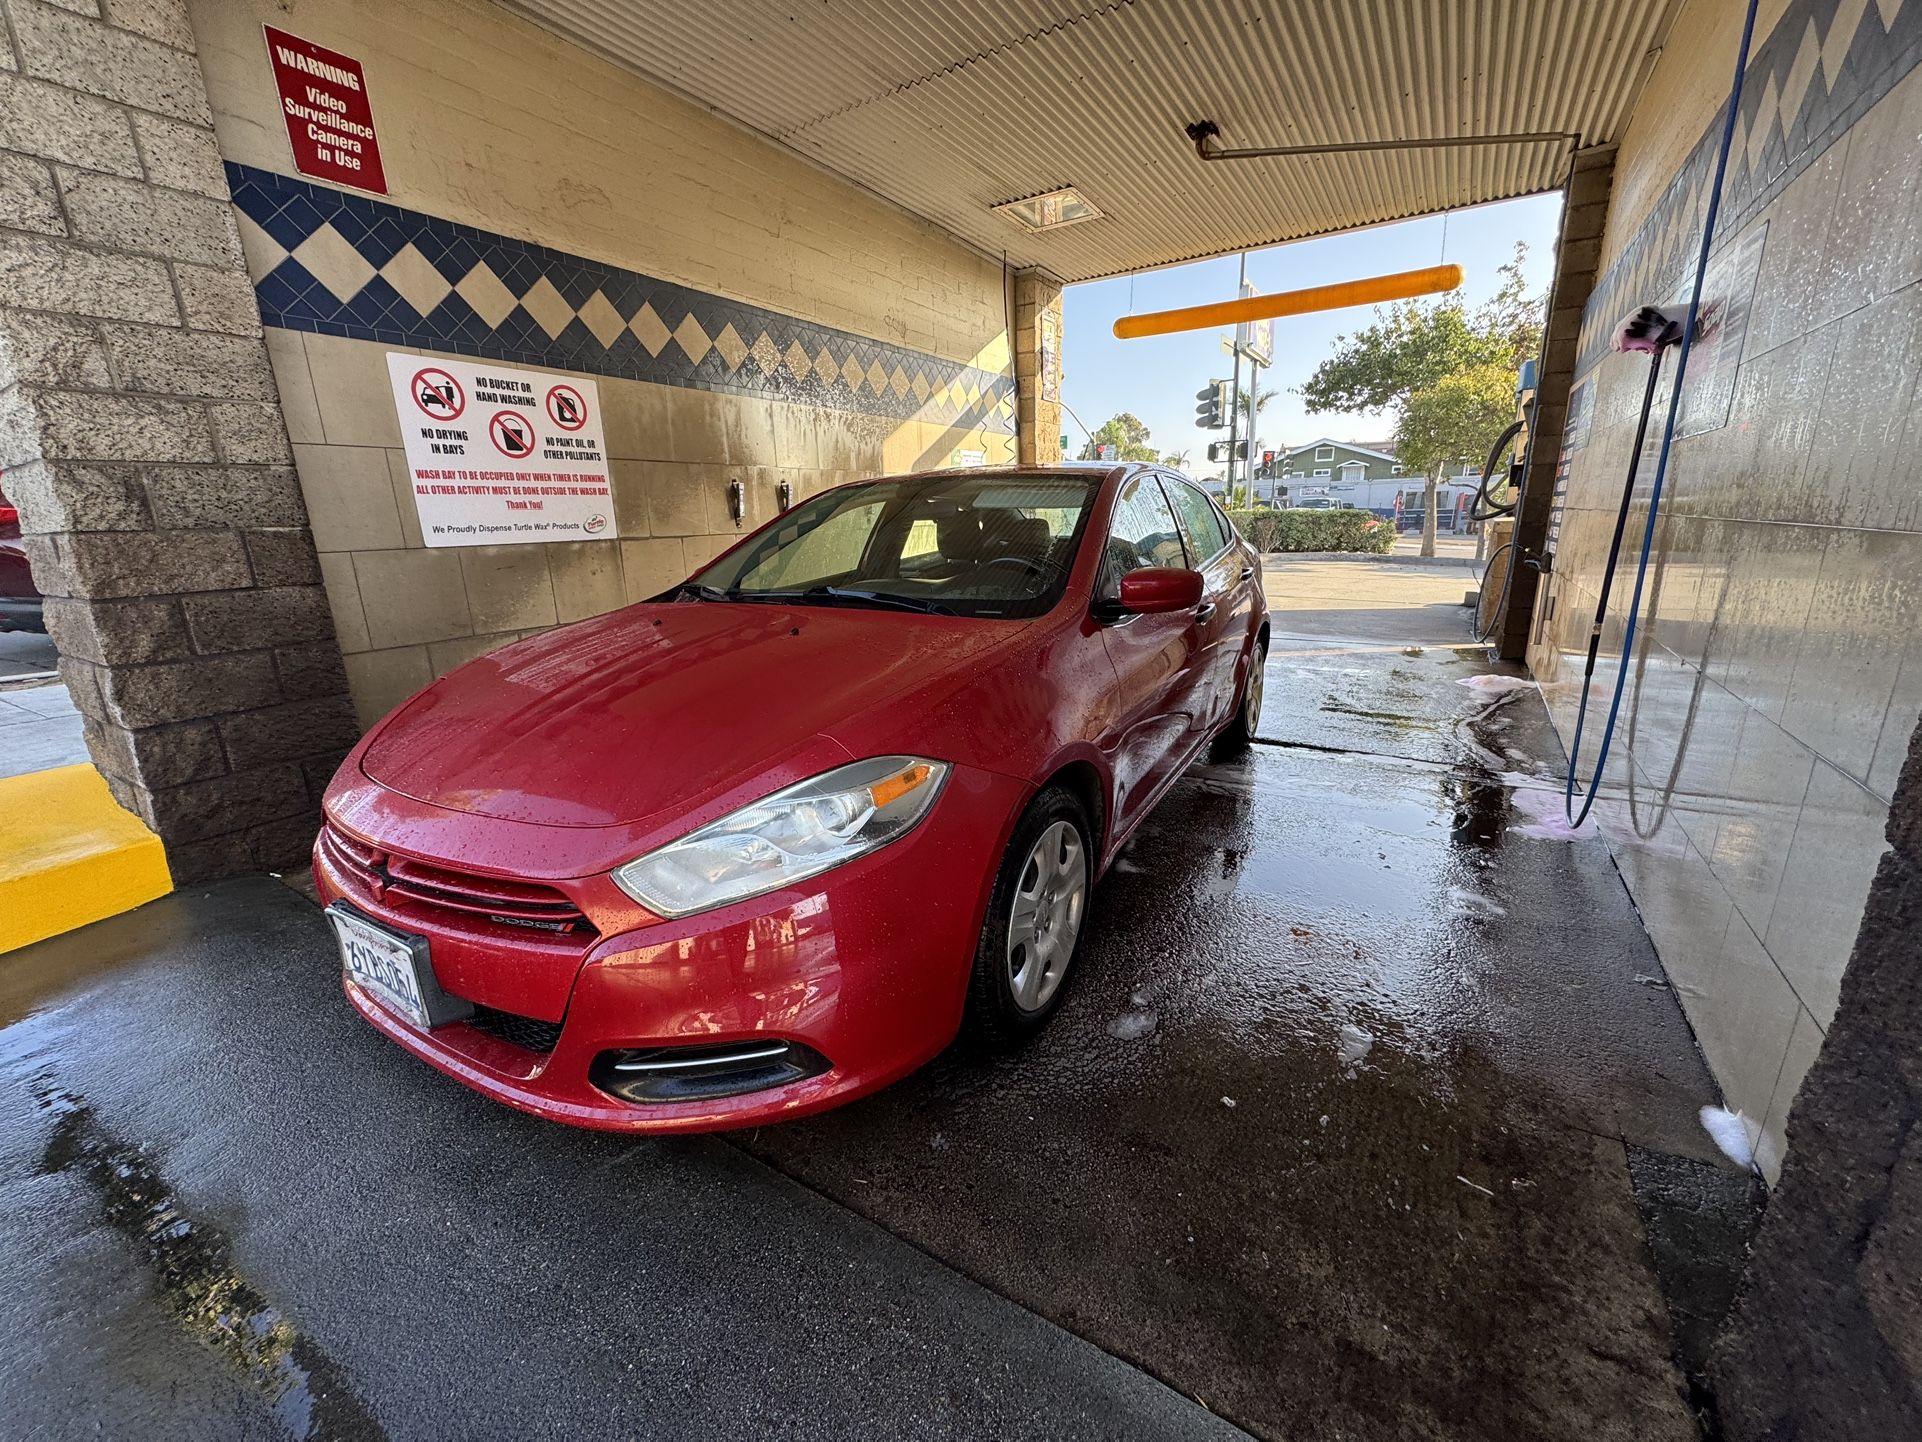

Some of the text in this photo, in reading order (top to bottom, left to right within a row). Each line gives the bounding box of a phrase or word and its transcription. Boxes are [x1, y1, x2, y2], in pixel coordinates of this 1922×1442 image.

[276, 45, 360, 91] WARNING
[305, 86, 346, 113] Video
[285, 97, 373, 140] Surveillance
[307, 123, 362, 154] Camera
[317, 145, 361, 171] in Use
[476, 377, 532, 393] NO BUCKET OR
[476, 391, 537, 407] HAND WASHING
[421, 428, 469, 441] NO DRYING
[431, 443, 465, 455] IN BAYS
[545, 437, 555, 447] NO
[587, 439, 596, 449] OR
[544, 450, 601, 462] OTHER POLLUTANTS
[415, 470, 605, 483] WASH BAY TO BE OCCUPIED ONLY WHEN TIMER IS RUNNING
[416, 485, 430, 494] ALL
[431, 485, 456, 495] OTHER
[457, 485, 490, 495] ACTIVITY
[491, 486, 511, 495] MUST
[513, 486, 521, 495] BE
[522, 487, 540, 495] DONE
[540, 487, 567, 495] OUTSIDE
[567, 487, 579, 495] THE
[505, 500, 543, 509] Thank You!
[432, 525, 445, 533] We
[447, 525, 477, 534] Proudly
[479, 525, 512, 533] Dispense
[514, 523, 533, 531] Turtle
[552, 522, 579, 530] Products
[491, 915, 560, 930] DODGE
